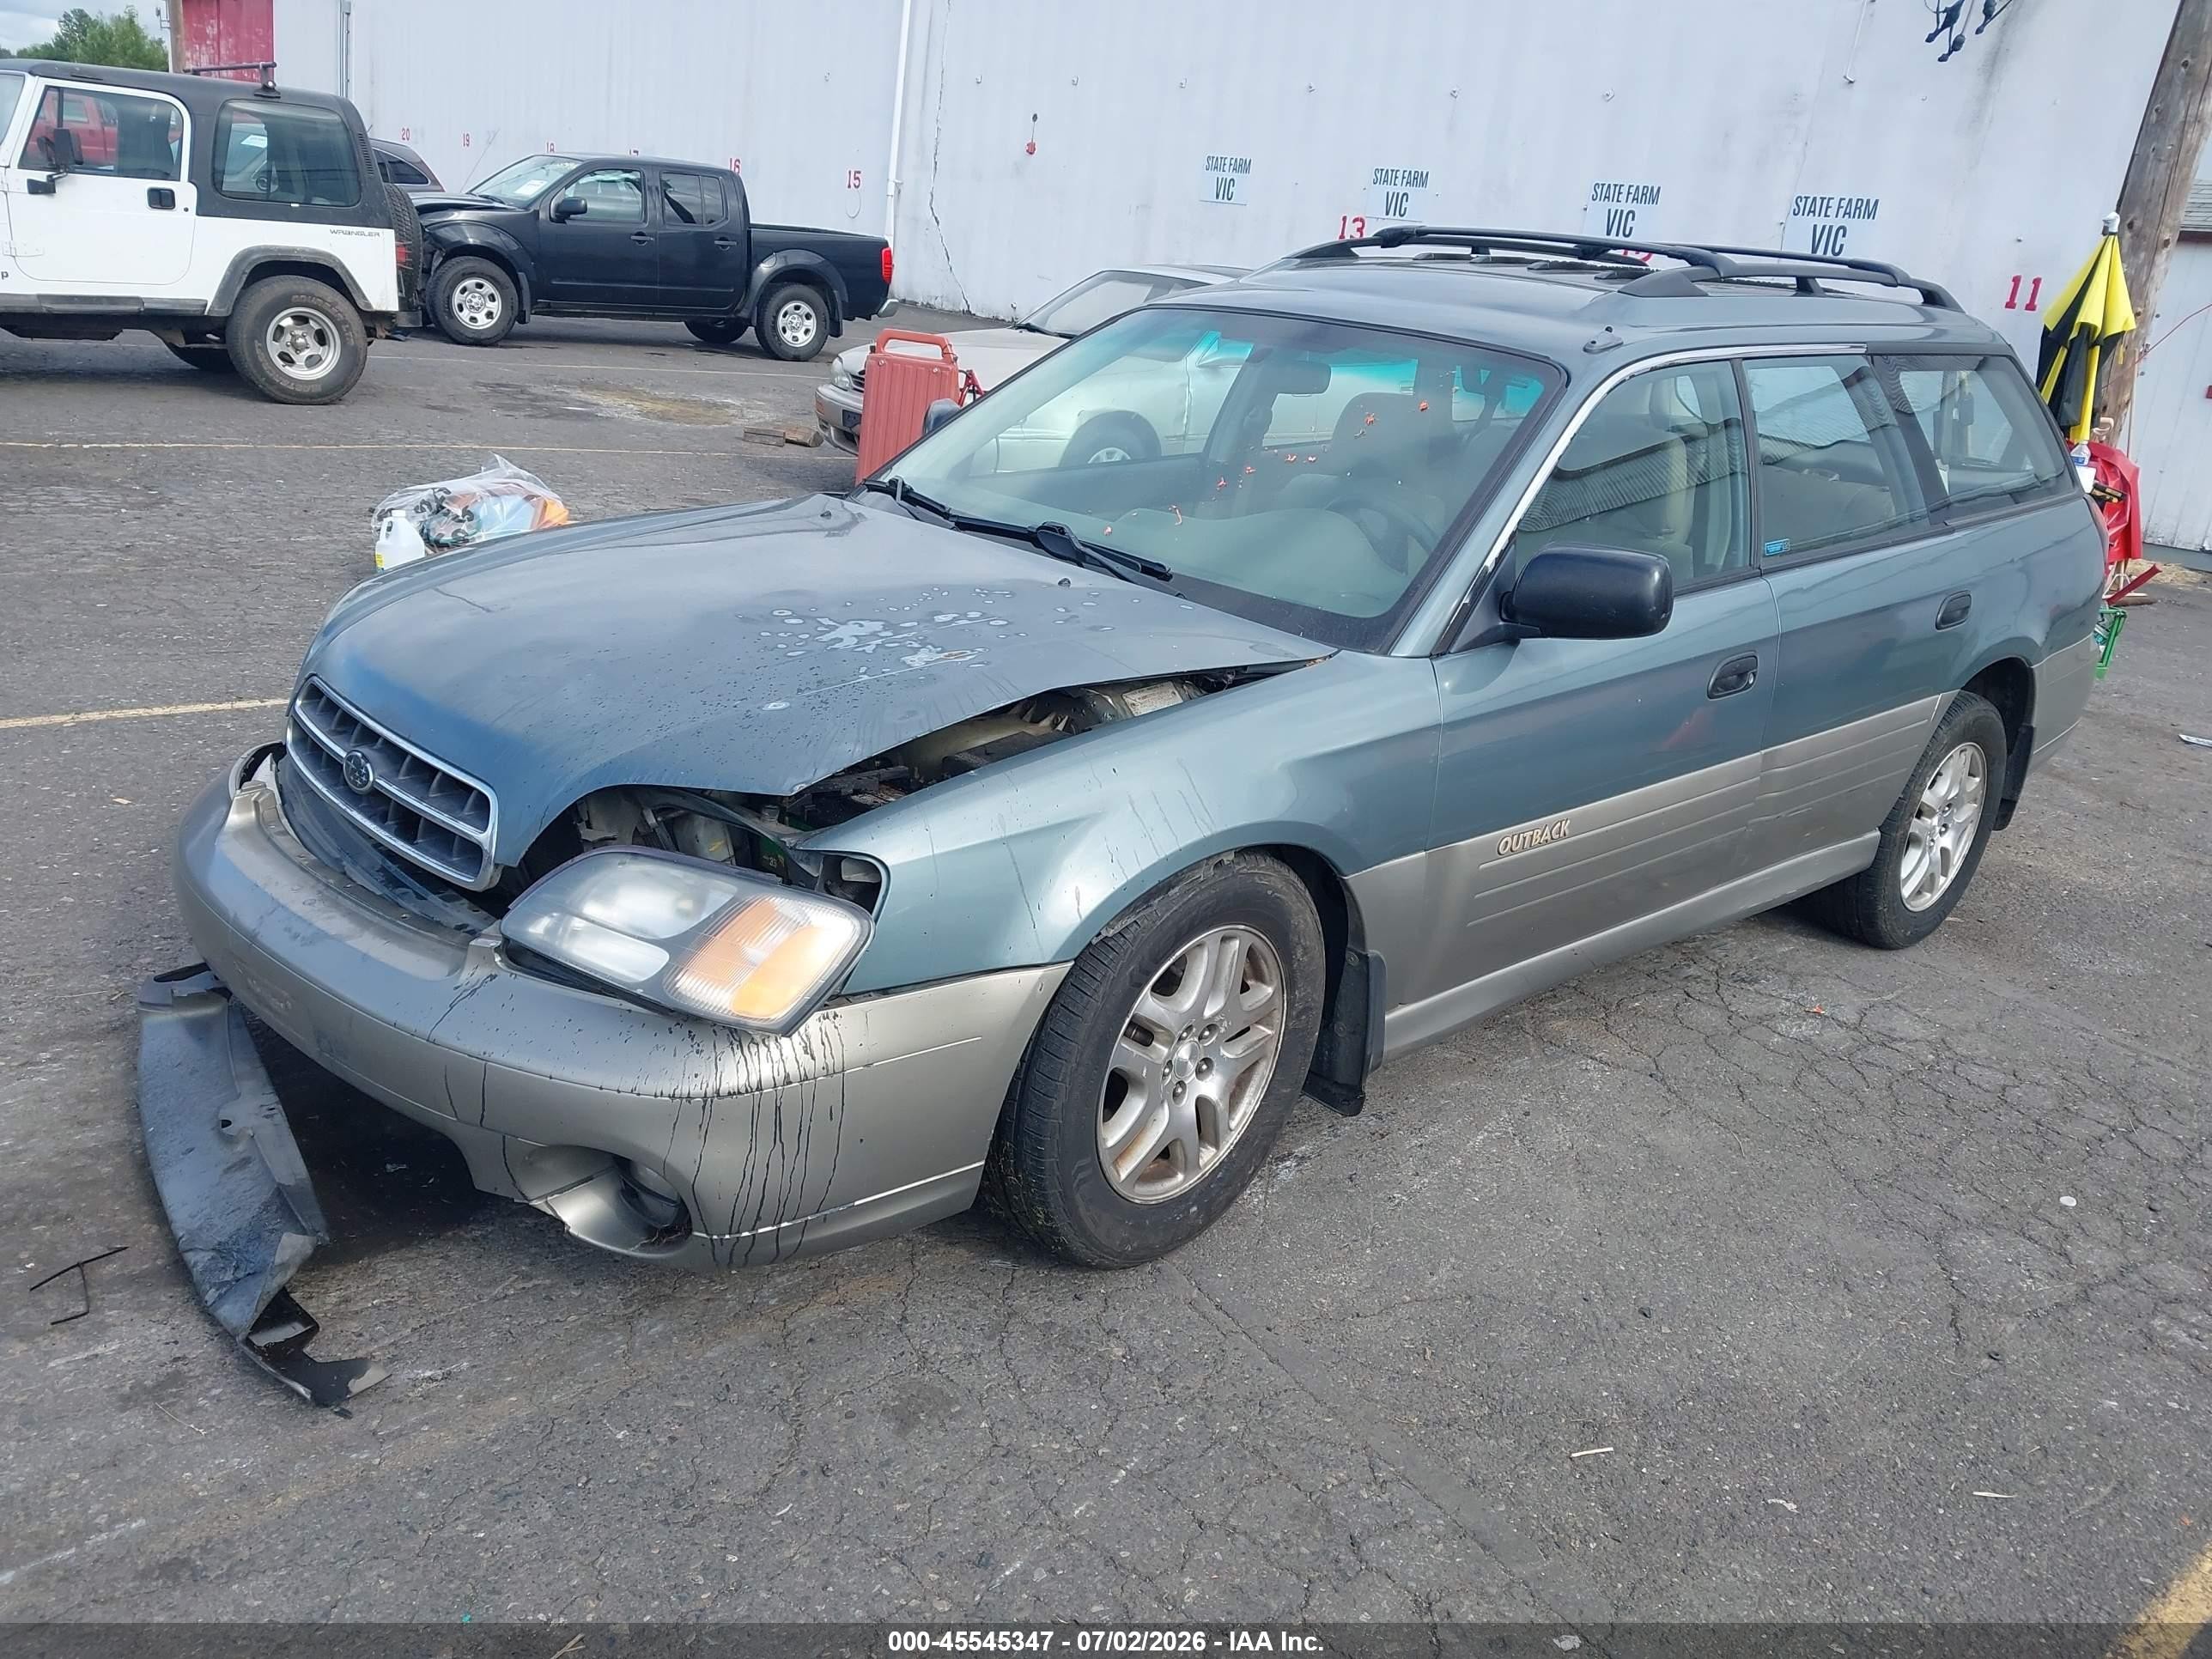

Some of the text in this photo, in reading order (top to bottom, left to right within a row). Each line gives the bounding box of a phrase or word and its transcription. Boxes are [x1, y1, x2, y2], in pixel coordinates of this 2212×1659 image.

[401, 128, 410, 141] 20
[462, 132, 471, 147] 19
[1205, 155, 1252, 174] STATE FARM
[847, 169, 862, 189] 15
[1215, 177, 1236, 201] VIC
[1372, 168, 1430, 188] STATE FARM
[1385, 191, 1409, 217] VIC
[1591, 182, 1662, 206] STATE FARM
[1792, 195, 1881, 221] STATE FARM
[1338, 215, 1366, 240] 13
[1606, 208, 1636, 239] VIC
[1810, 223, 1848, 257] VIC
[2004, 275, 2042, 312] 11
[1497, 817, 1571, 855] OUTBACK
